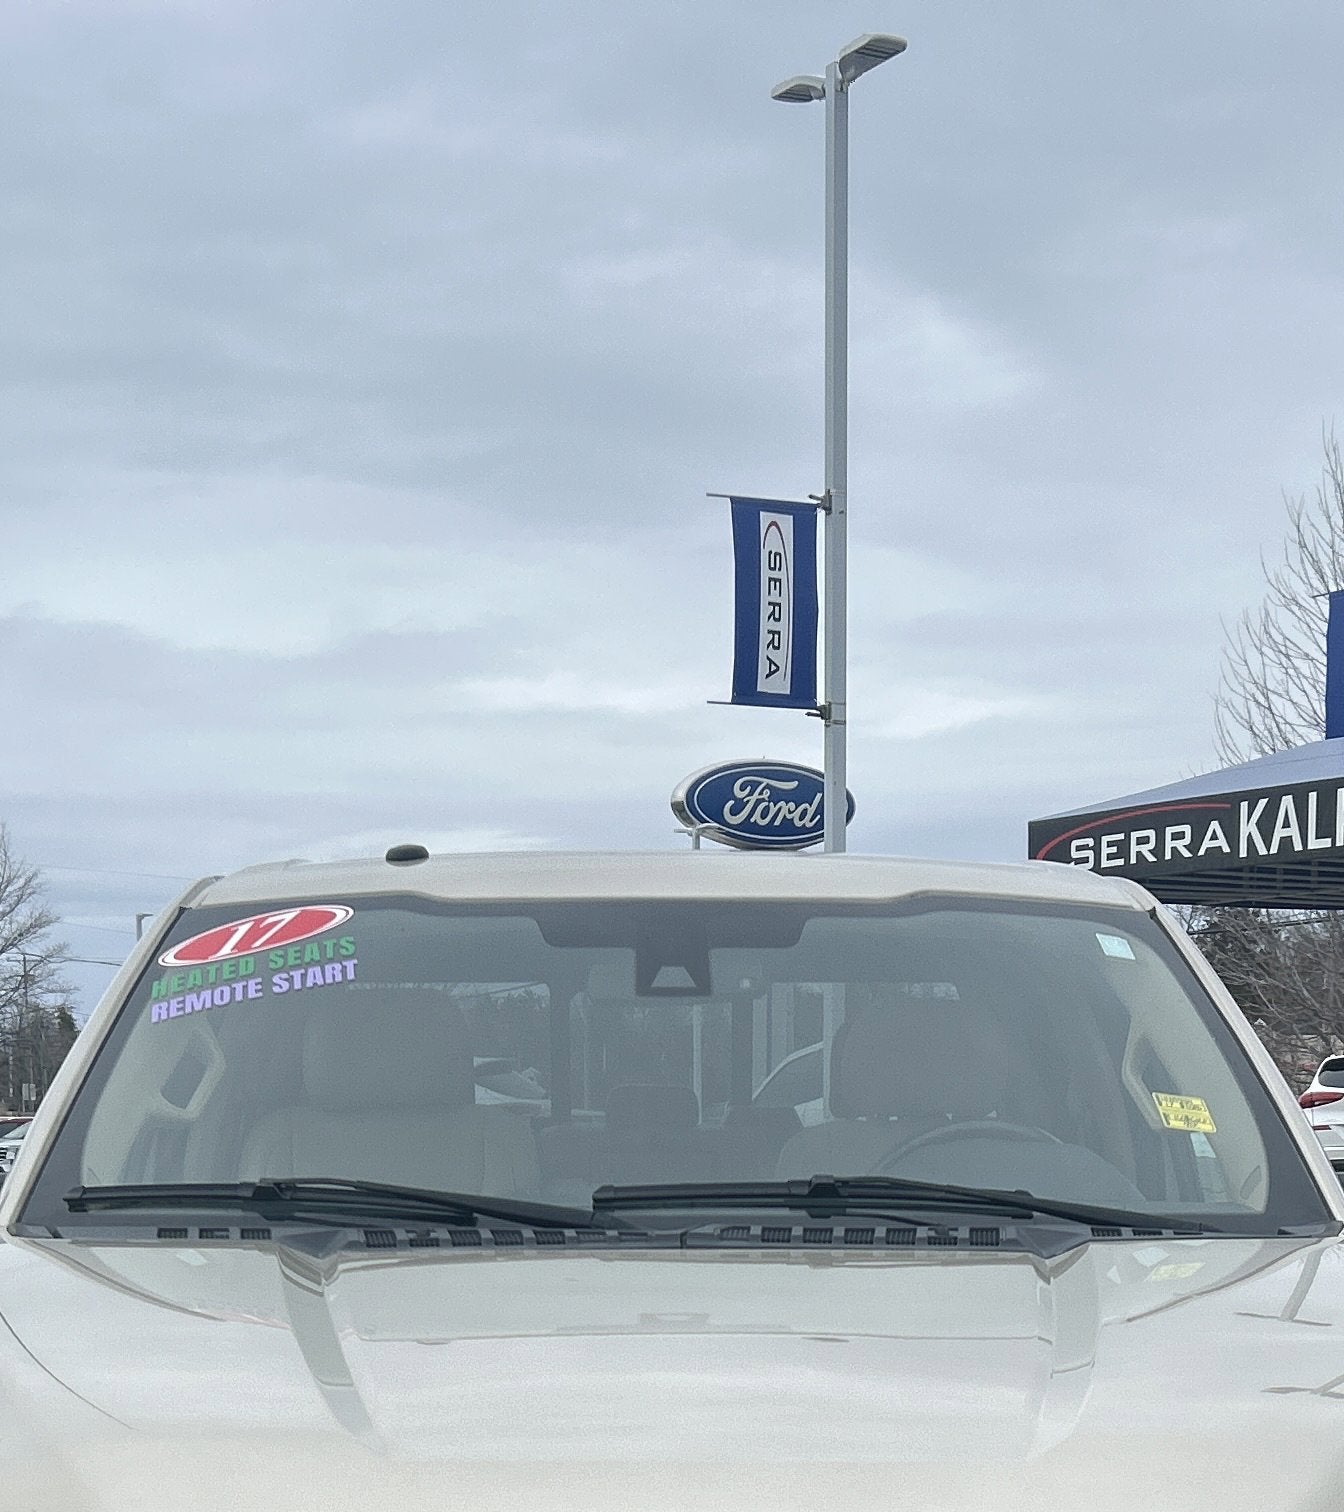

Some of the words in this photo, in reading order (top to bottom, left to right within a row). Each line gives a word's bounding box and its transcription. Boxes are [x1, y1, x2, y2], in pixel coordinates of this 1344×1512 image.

[764, 550, 783, 680] SERRA
[723, 775, 823, 829] Ford
[1070, 820, 1231, 870] SERRA
[207, 908, 303, 961] 17
[150, 958, 256, 1000] HEATED
[268, 936, 356, 970] SEATS
[150, 977, 263, 1024] REMOTE
[272, 959, 358, 994] START
